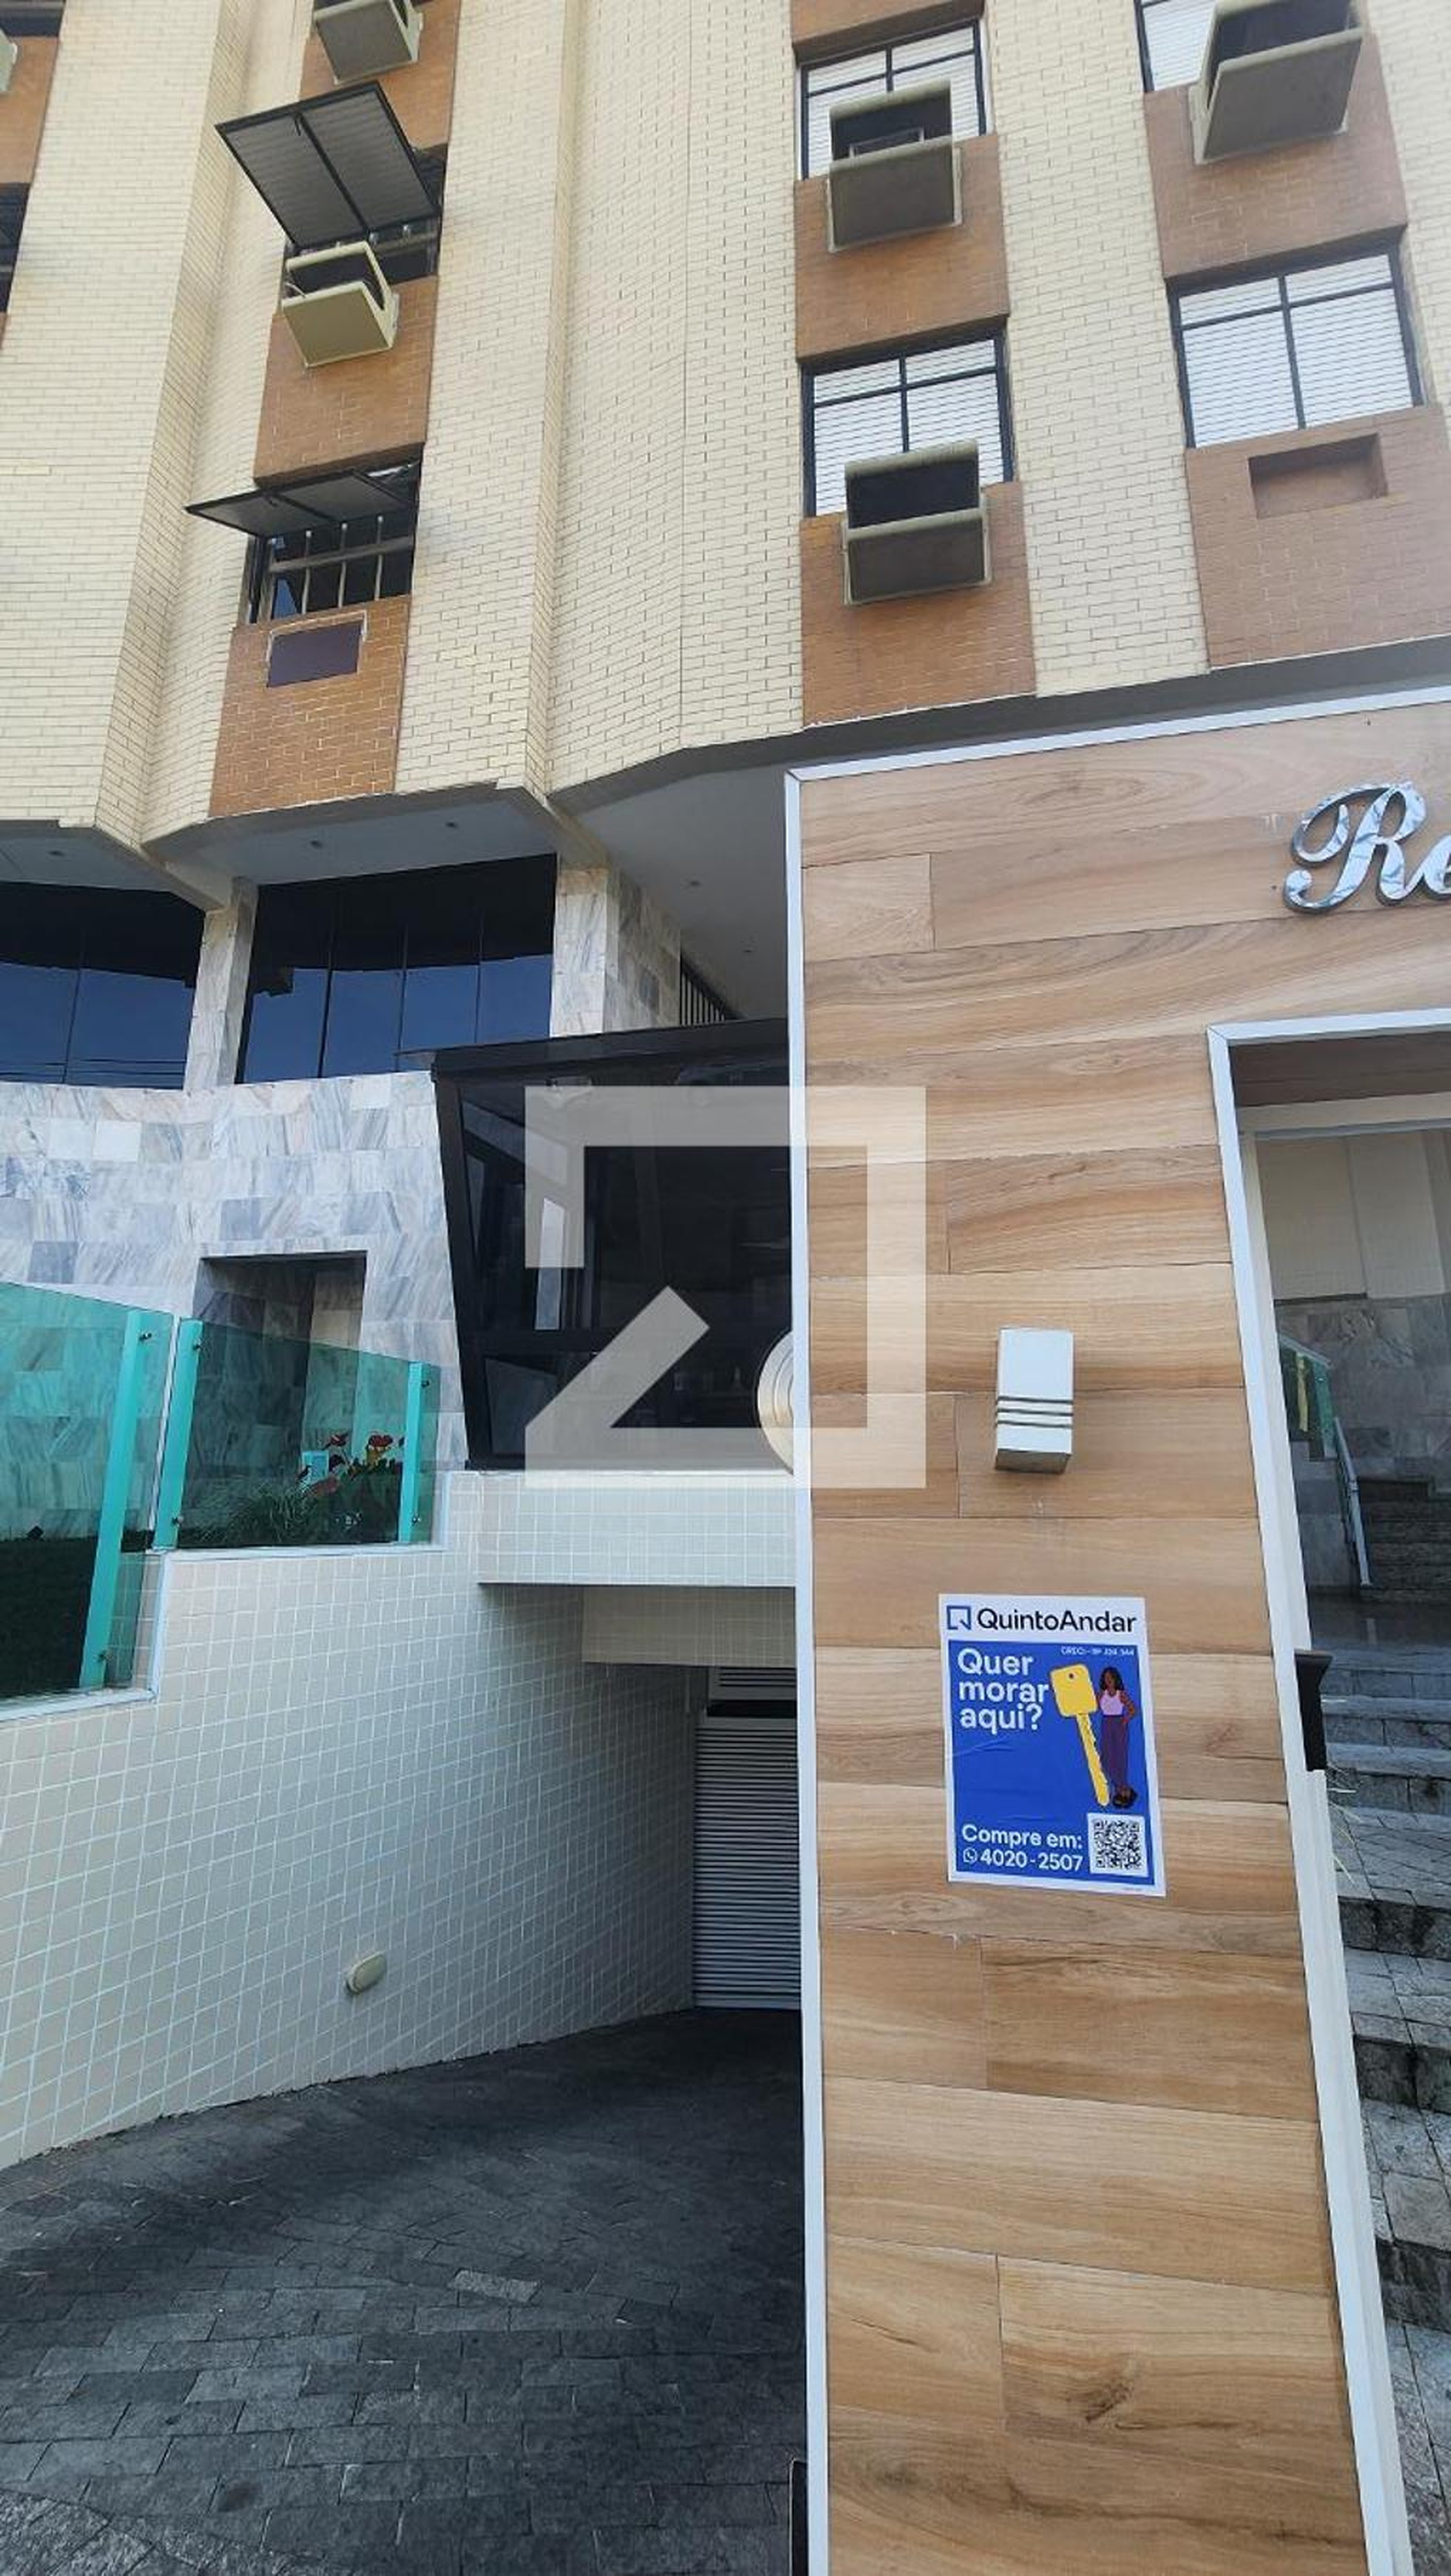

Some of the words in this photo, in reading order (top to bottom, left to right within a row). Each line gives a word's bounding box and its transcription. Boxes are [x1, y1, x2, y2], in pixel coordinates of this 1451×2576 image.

[977, 1608, 1137, 1632] QuintoAndar
[958, 1648, 1033, 1676] Quer
[959, 1681, 1049, 1702] morar
[960, 1703, 1043, 1735] aqui?
[962, 1824, 1042, 1849] Compre
[1047, 1832, 1083, 1849] em:
[980, 1848, 1083, 1871] 4020-2507
